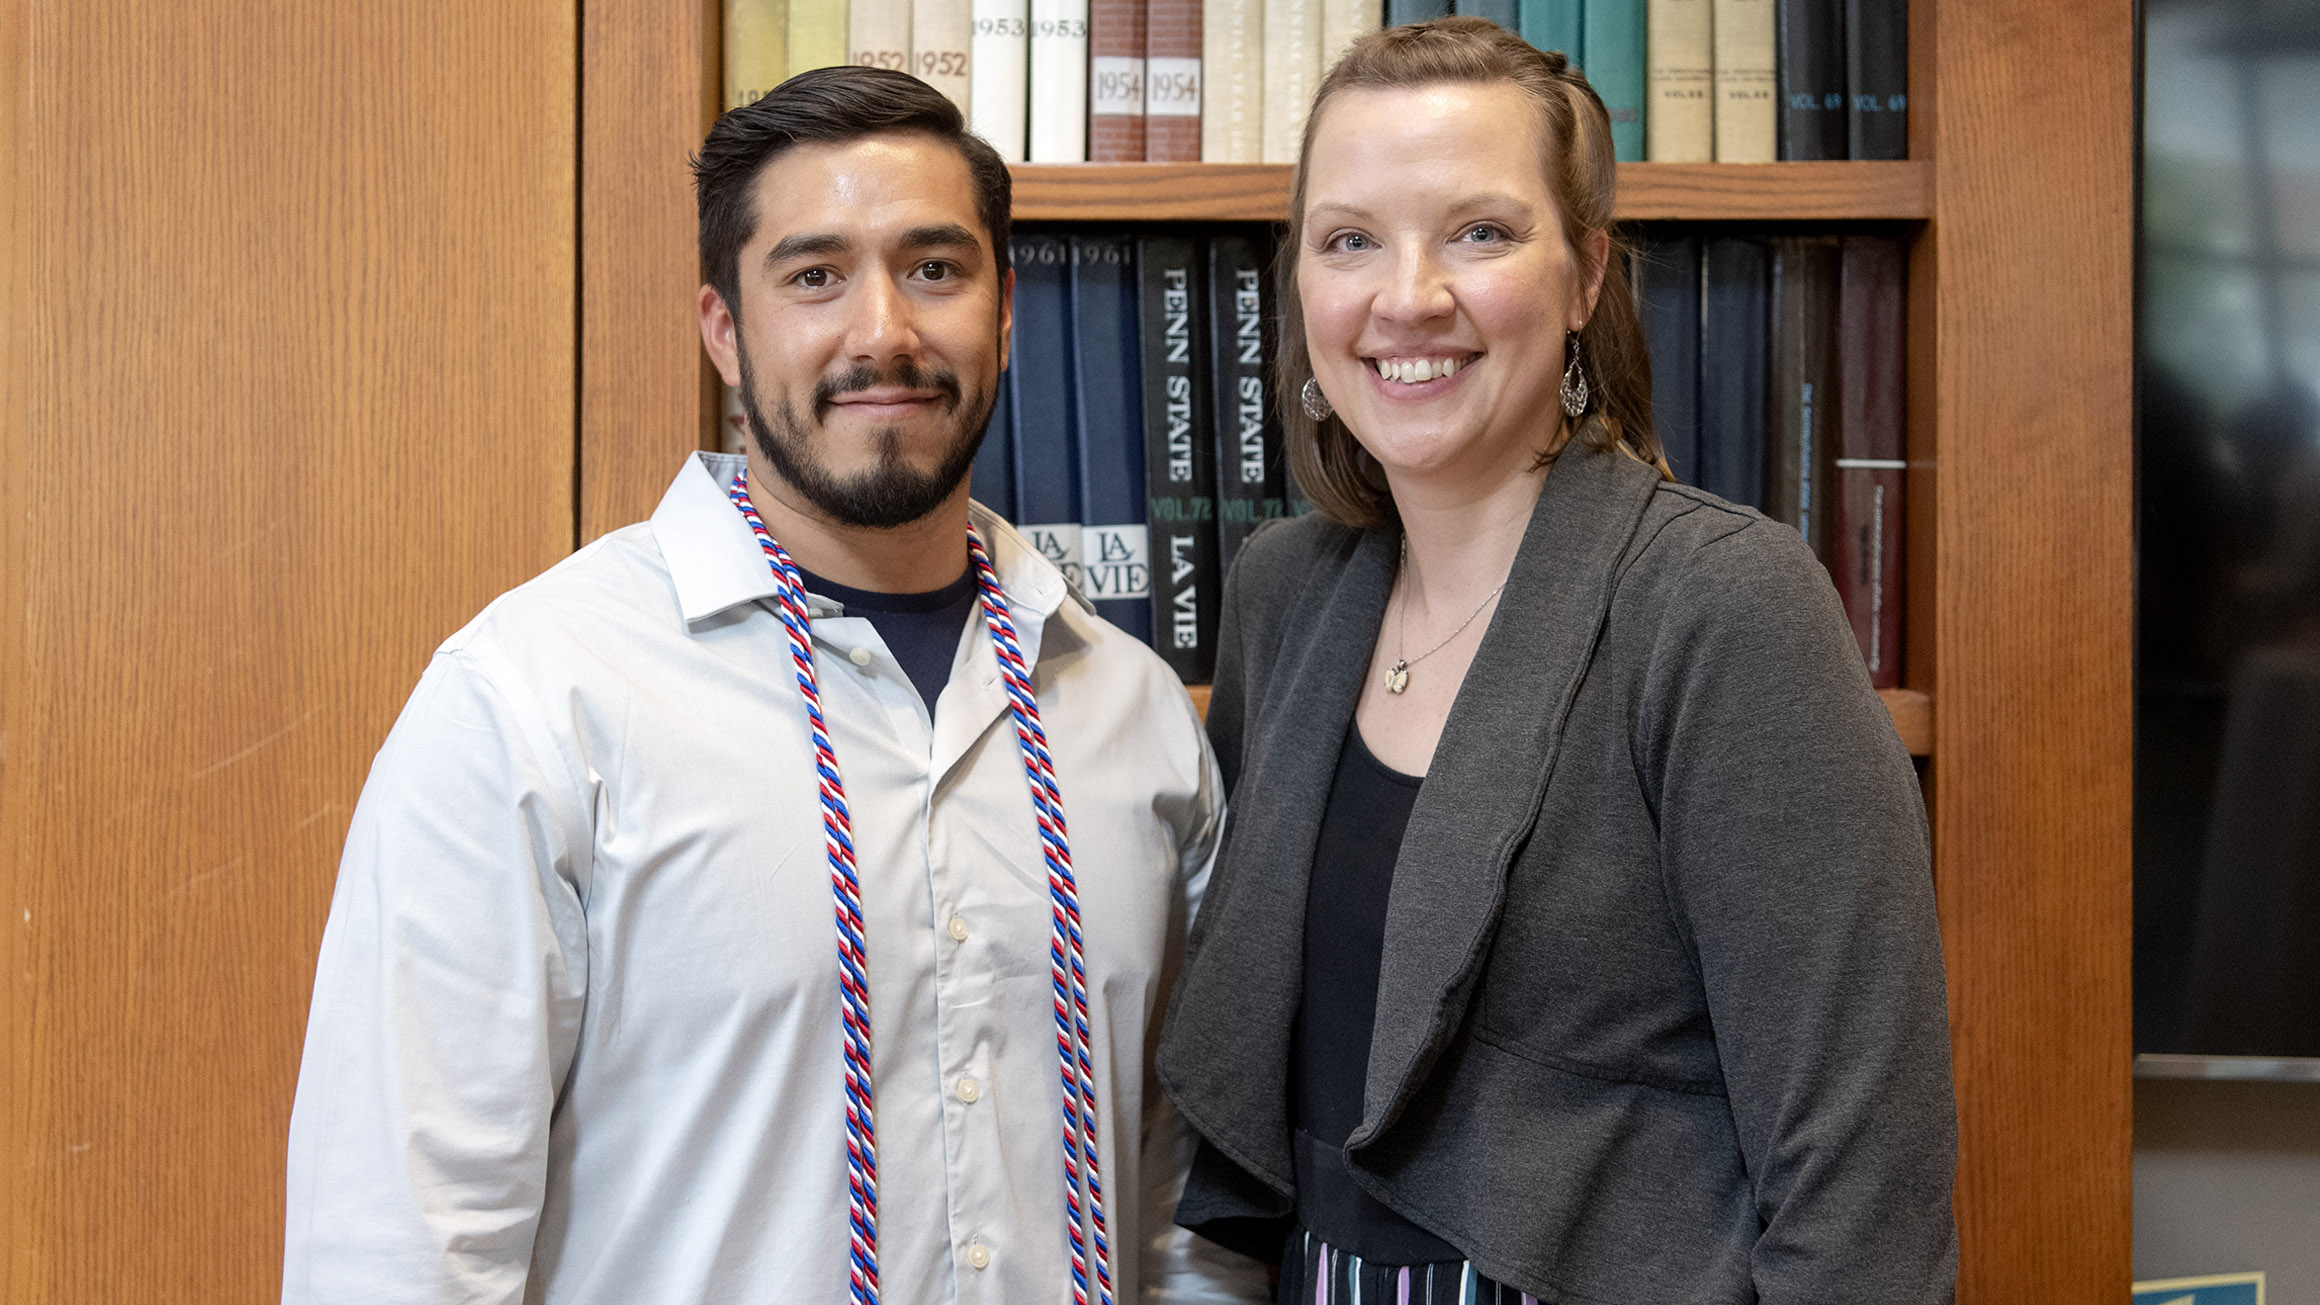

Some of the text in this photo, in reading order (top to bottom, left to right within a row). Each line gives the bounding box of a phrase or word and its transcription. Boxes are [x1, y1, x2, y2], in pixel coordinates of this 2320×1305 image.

[971, 18, 1024, 37] 1953
[1032, 18, 1086, 37] 1953
[915, 52, 967, 77] 1952
[1098, 71, 1142, 102] 1954
[1152, 72, 1197, 102] 1954
[1163, 267, 1193, 482] PENN STATE
[1235, 267, 1265, 484] PENN STATE
[1098, 532, 1136, 562] LA
[1087, 563, 1149, 594] VIE
[1171, 535, 1198, 649] LA VIE
